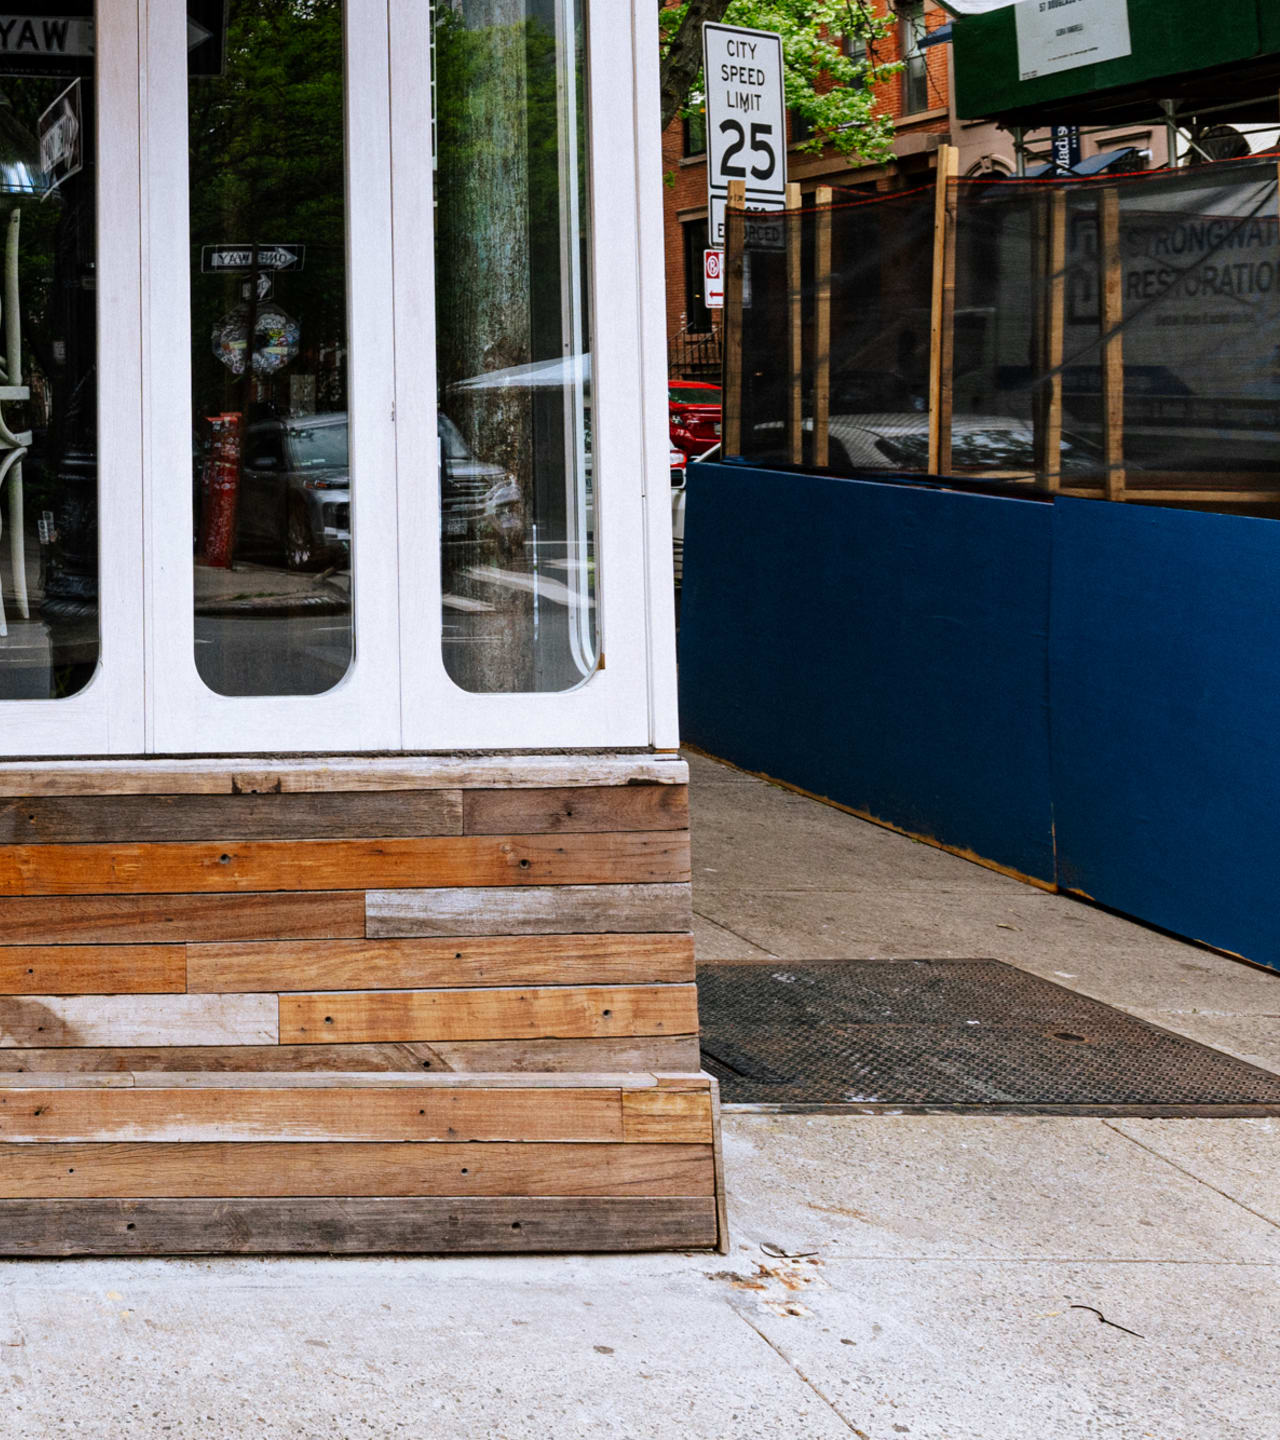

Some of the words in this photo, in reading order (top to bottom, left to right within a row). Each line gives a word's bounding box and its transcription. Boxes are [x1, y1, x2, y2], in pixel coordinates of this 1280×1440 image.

[726, 39, 758, 60] CITY
[721, 64, 765, 86] SPEED
[726, 90, 762, 111] LIMIT
[718, 118, 776, 181] 25
[717, 222, 780, 242] ERCED
[1127, 260, 1280, 300] RESTORATIO
